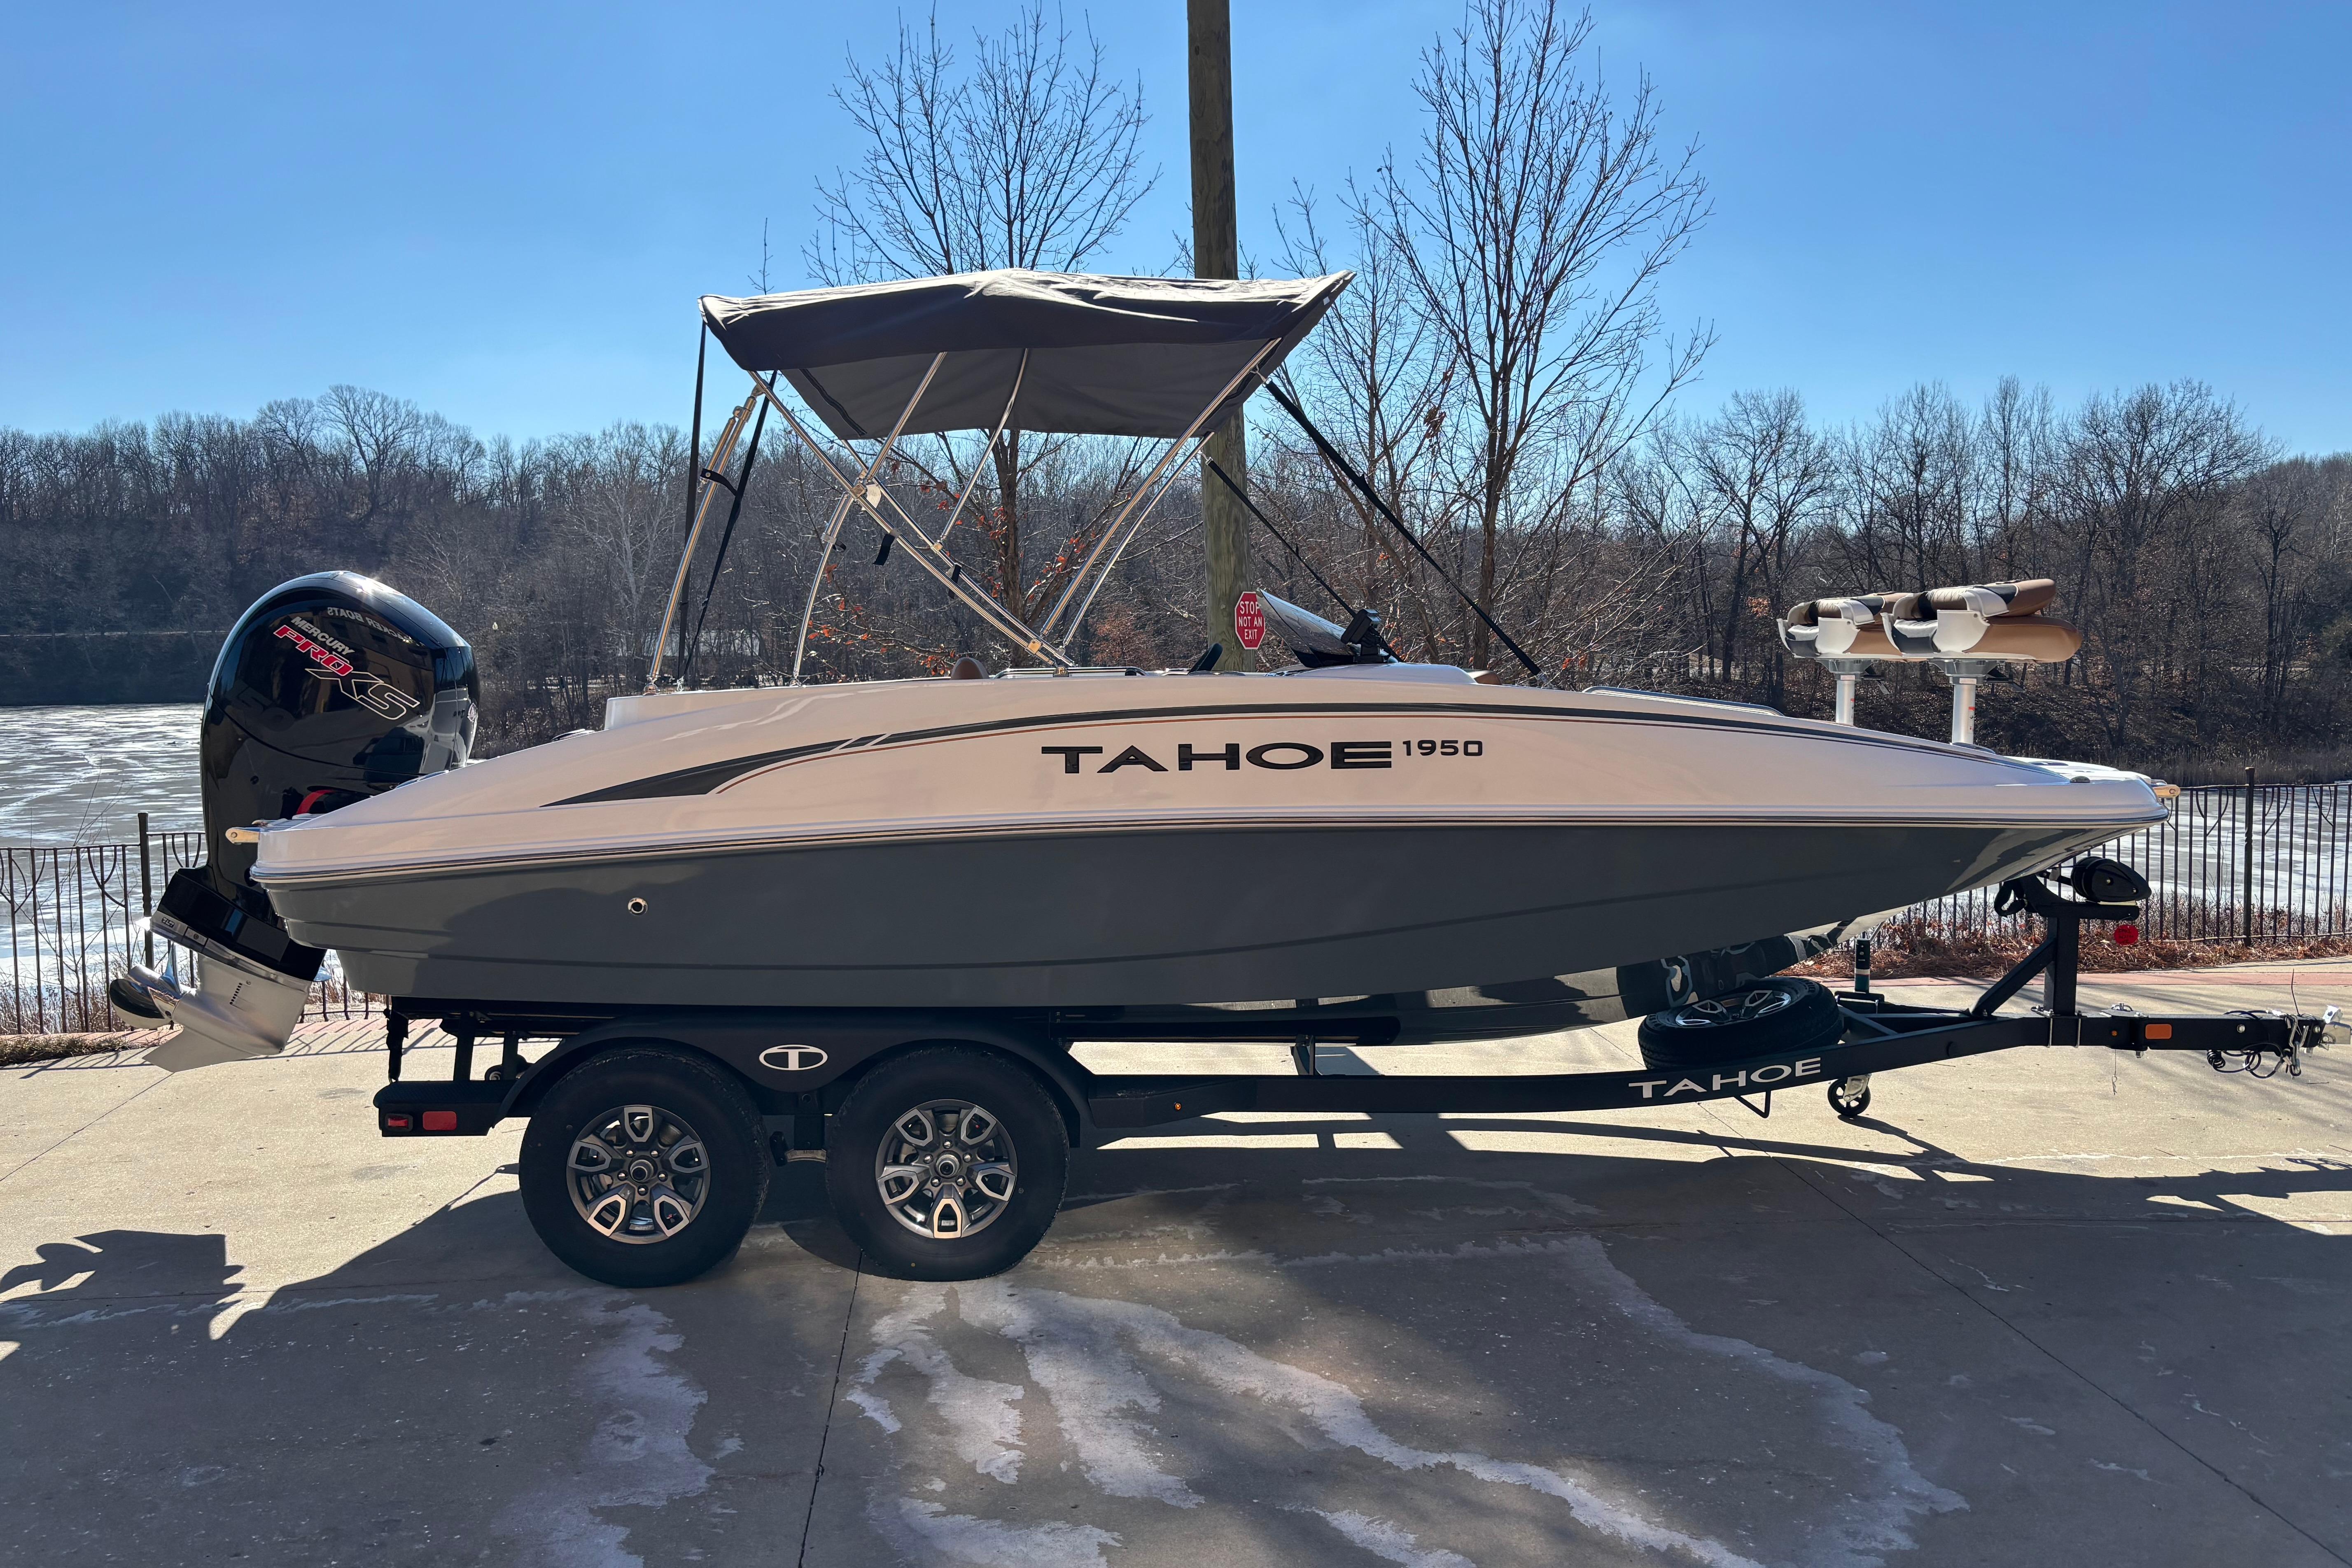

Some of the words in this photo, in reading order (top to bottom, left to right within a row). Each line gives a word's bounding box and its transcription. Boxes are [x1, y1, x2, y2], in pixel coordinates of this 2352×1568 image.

[1239, 616, 1251, 627] NOT
[1253, 616, 1262, 627] AN
[1240, 601, 1260, 614] STOP
[273, 625, 353, 676] PRO
[291, 616, 355, 655] MERCURY
[1244, 629, 1258, 639] EXIT
[305, 668, 420, 720] XS
[1041, 742, 1392, 773] TAHOE
[1402, 740, 1483, 757] 1950
[1628, 1057, 1821, 1099] TAHOE
